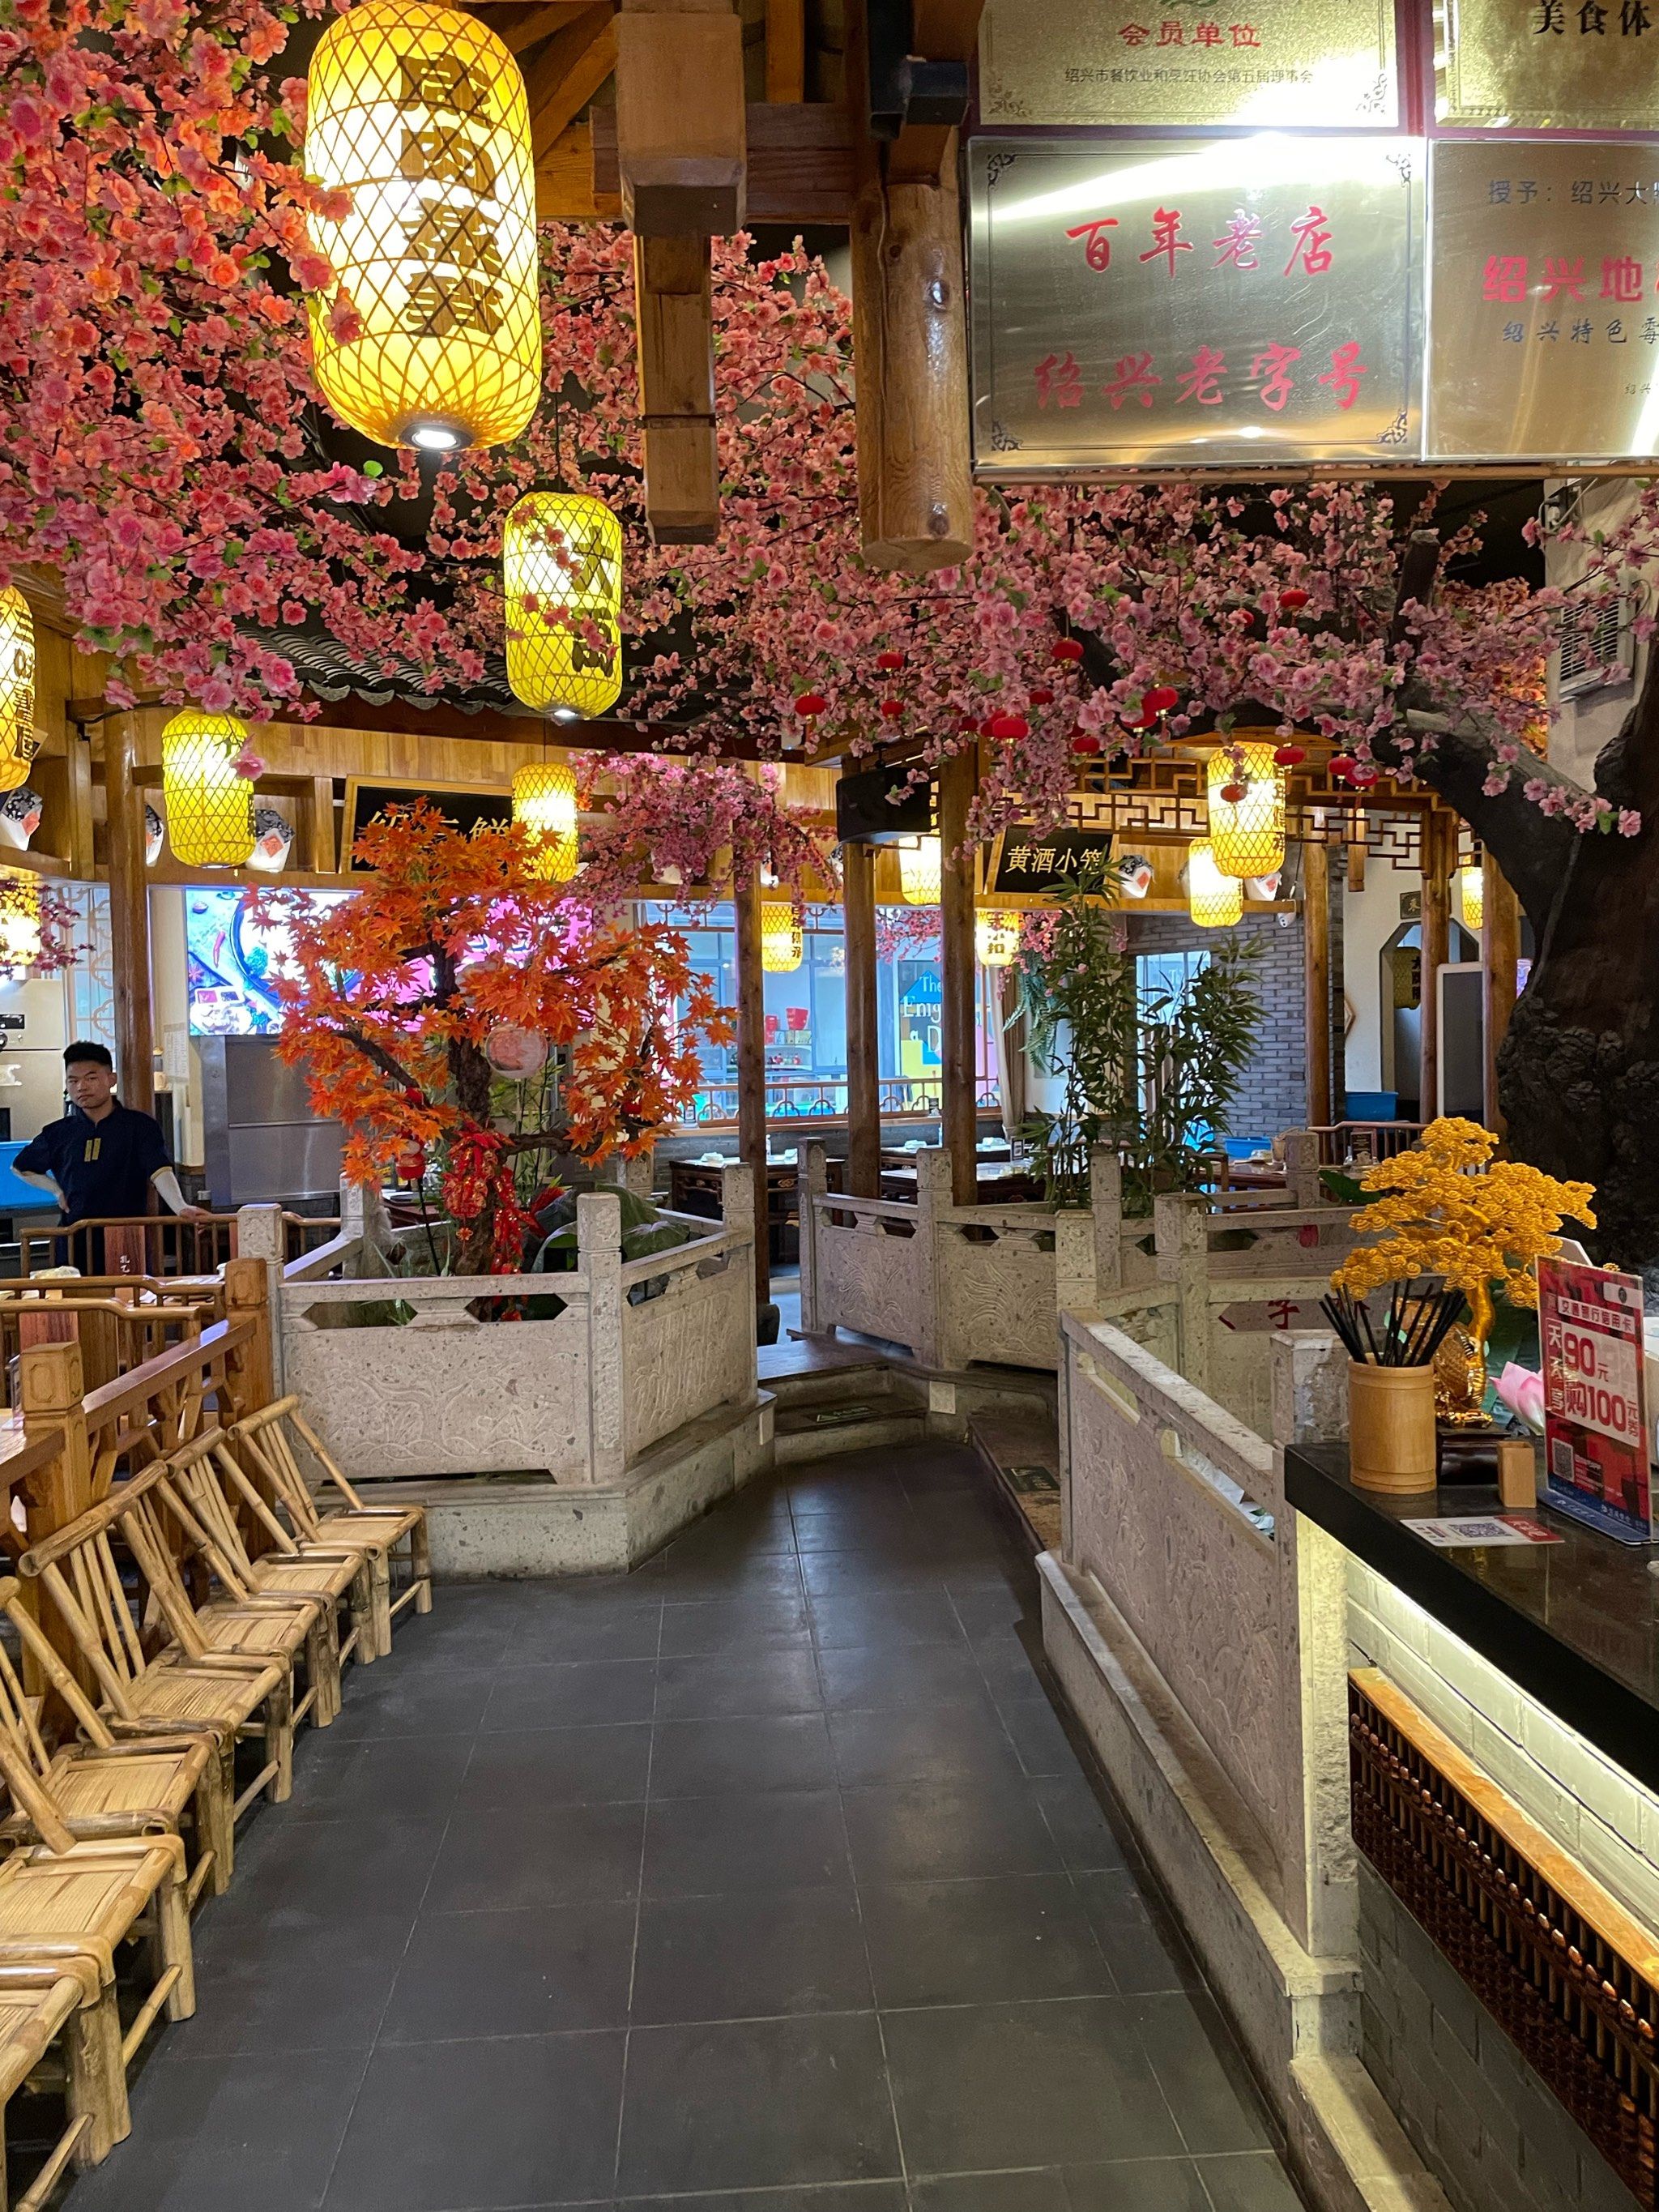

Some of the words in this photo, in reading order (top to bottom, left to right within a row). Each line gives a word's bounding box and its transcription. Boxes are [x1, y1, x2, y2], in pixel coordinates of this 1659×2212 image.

[1533, 0, 1652, 36] 美食体
[1119, 21, 1261, 48] 会员单位
[1064, 68, 1313, 83] 绍兴市餐饮业和烹饪协会第五届理事会
[1488, 180, 1659, 204] 授予：绍兴大
[1066, 206, 1335, 279] 百年老店
[1482, 255, 1659, 303] 绍兴地
[1033, 341, 1369, 412] 绍兴老字号
[902, 995, 941, 1023] Enig
